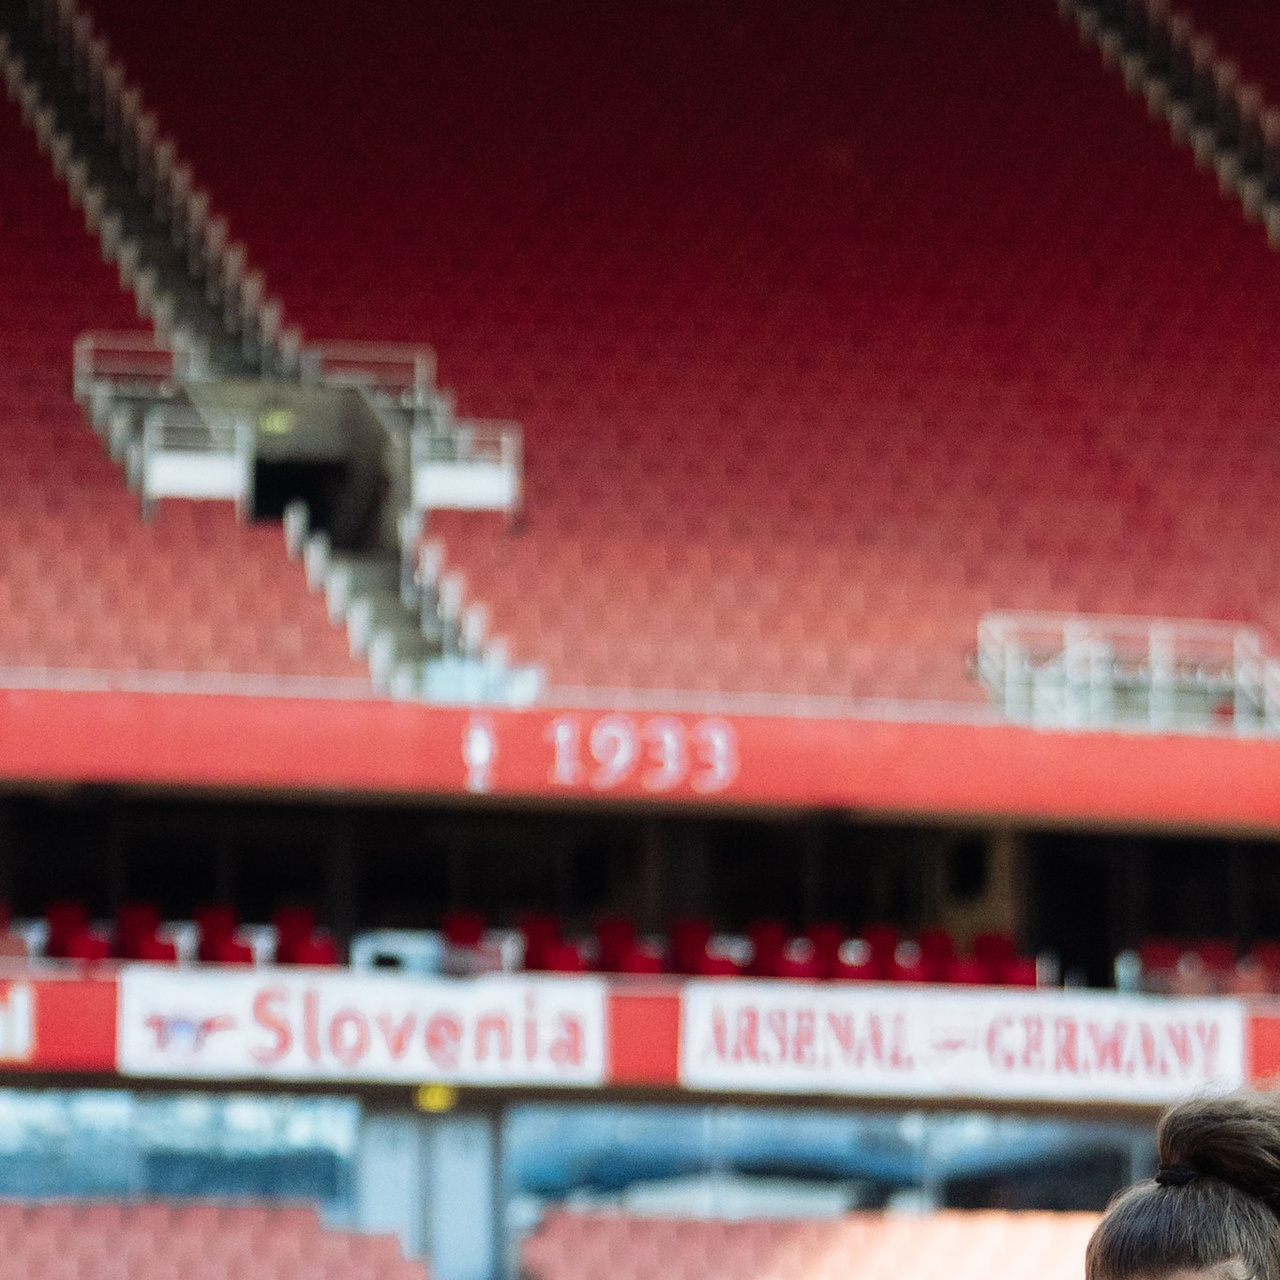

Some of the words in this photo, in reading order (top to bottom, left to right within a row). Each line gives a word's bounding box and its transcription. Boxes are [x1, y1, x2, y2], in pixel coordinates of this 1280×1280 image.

[543, 713, 741, 795] 1933
[252, 984, 586, 1072] Slovenia
[701, 1004, 914, 1071] ARSENAL
[985, 1010, 1219, 1078] GERMANY
